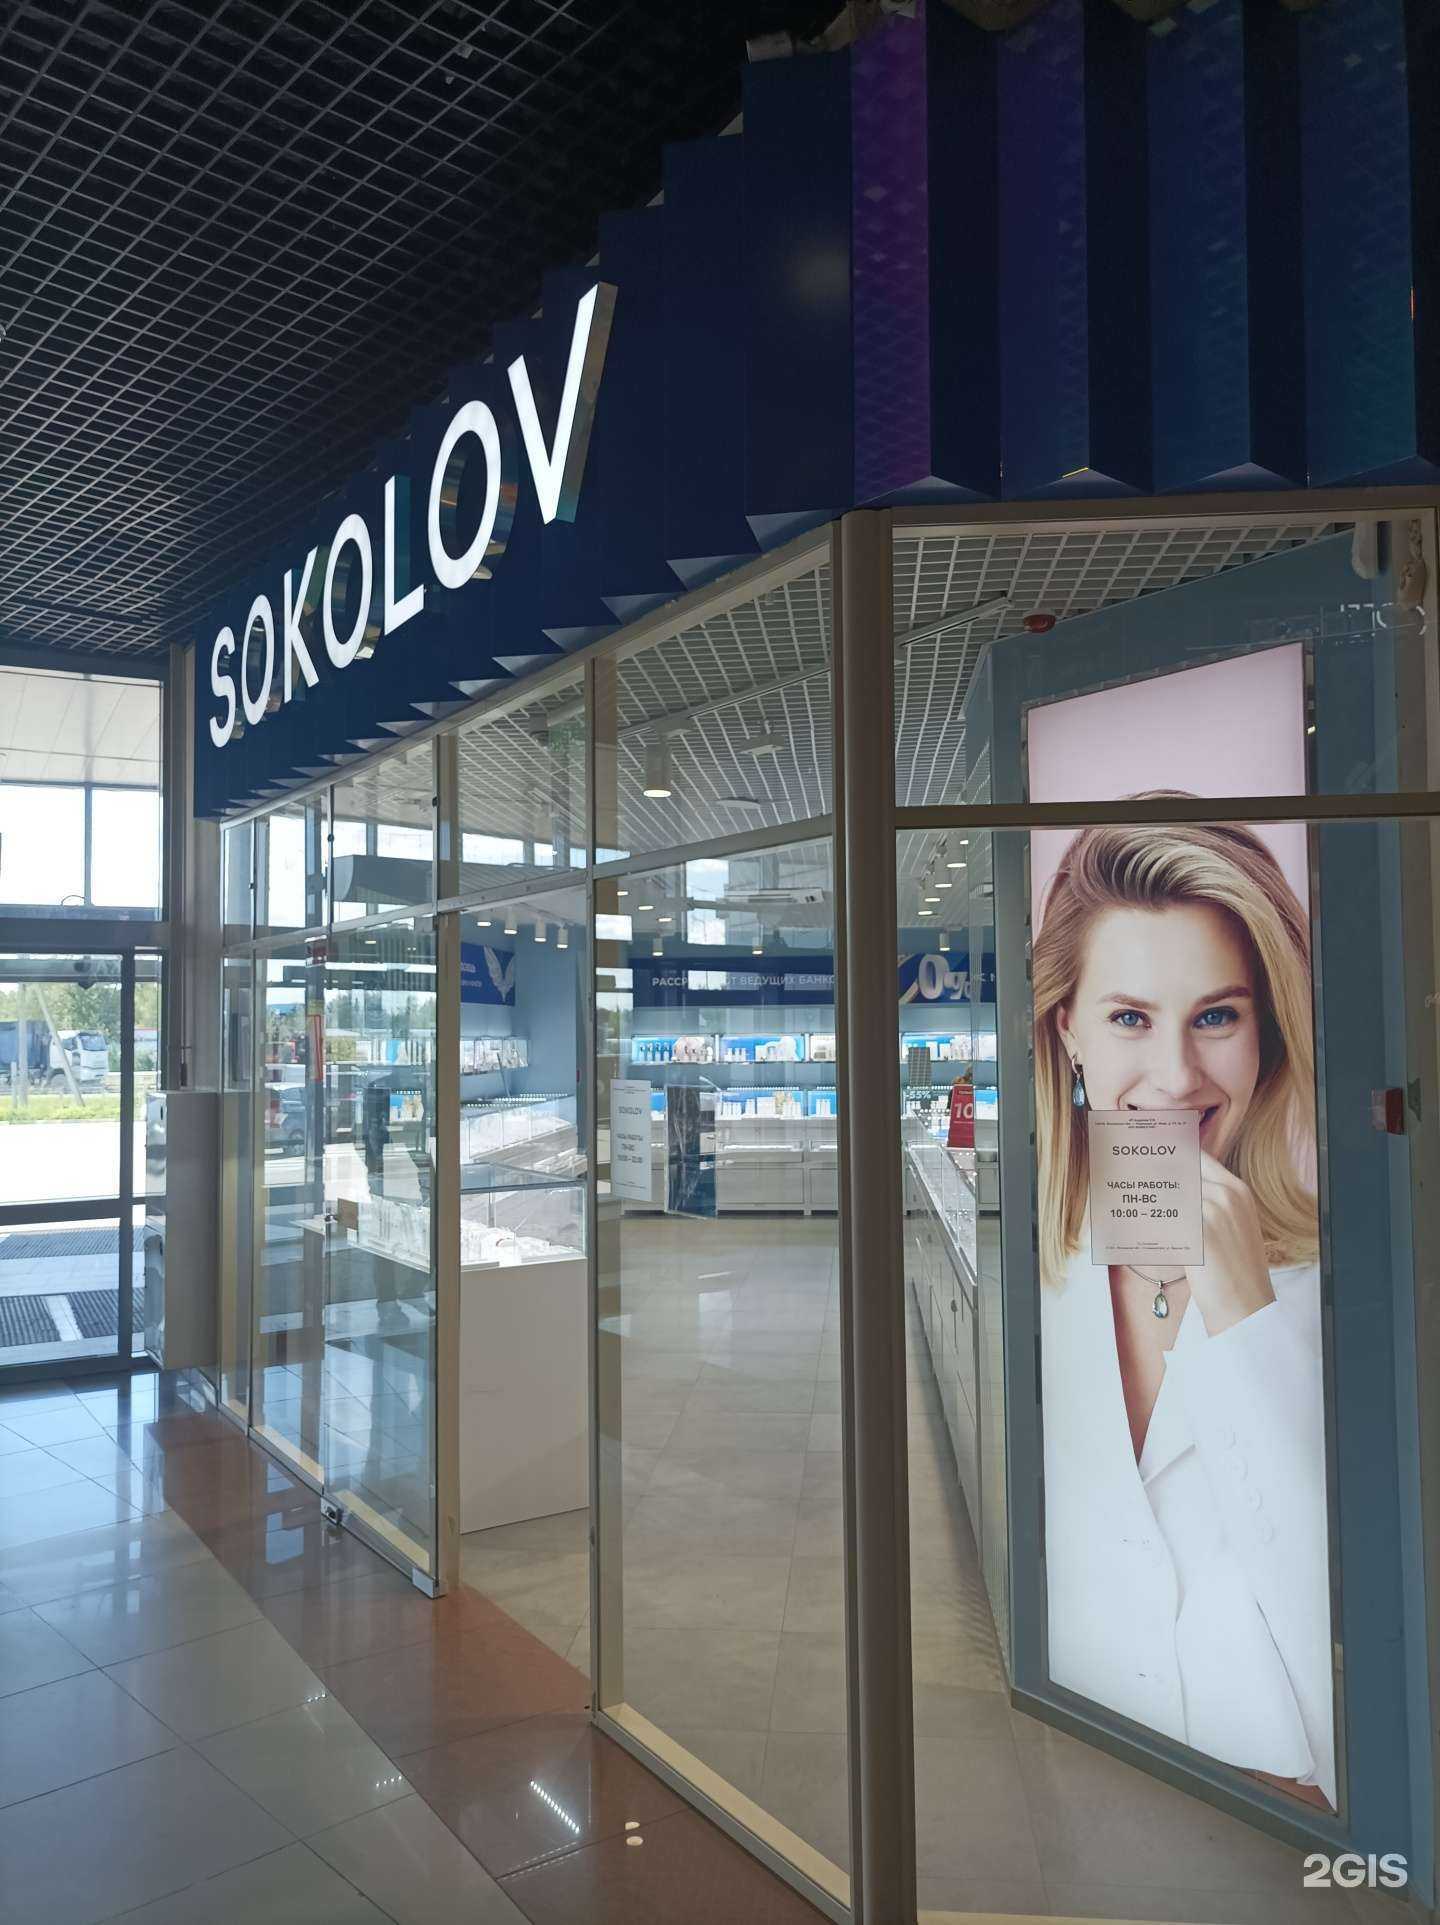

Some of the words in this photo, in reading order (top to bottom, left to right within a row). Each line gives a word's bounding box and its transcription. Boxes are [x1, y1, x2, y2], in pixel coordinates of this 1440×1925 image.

[209, 281, 602, 748] SOKOLOV
[1112, 1145, 1176, 1156] SOKOLOV
[1107, 1181, 1135, 1190] ЧАСЫ
[1137, 1181, 1180, 1190] РАБОТЫ:
[1122, 1194, 1157, 1204] ПН-ВС
[1110, 1208, 1138, 1218] 10:00
[1150, 1208, 1179, 1218] 22:00
